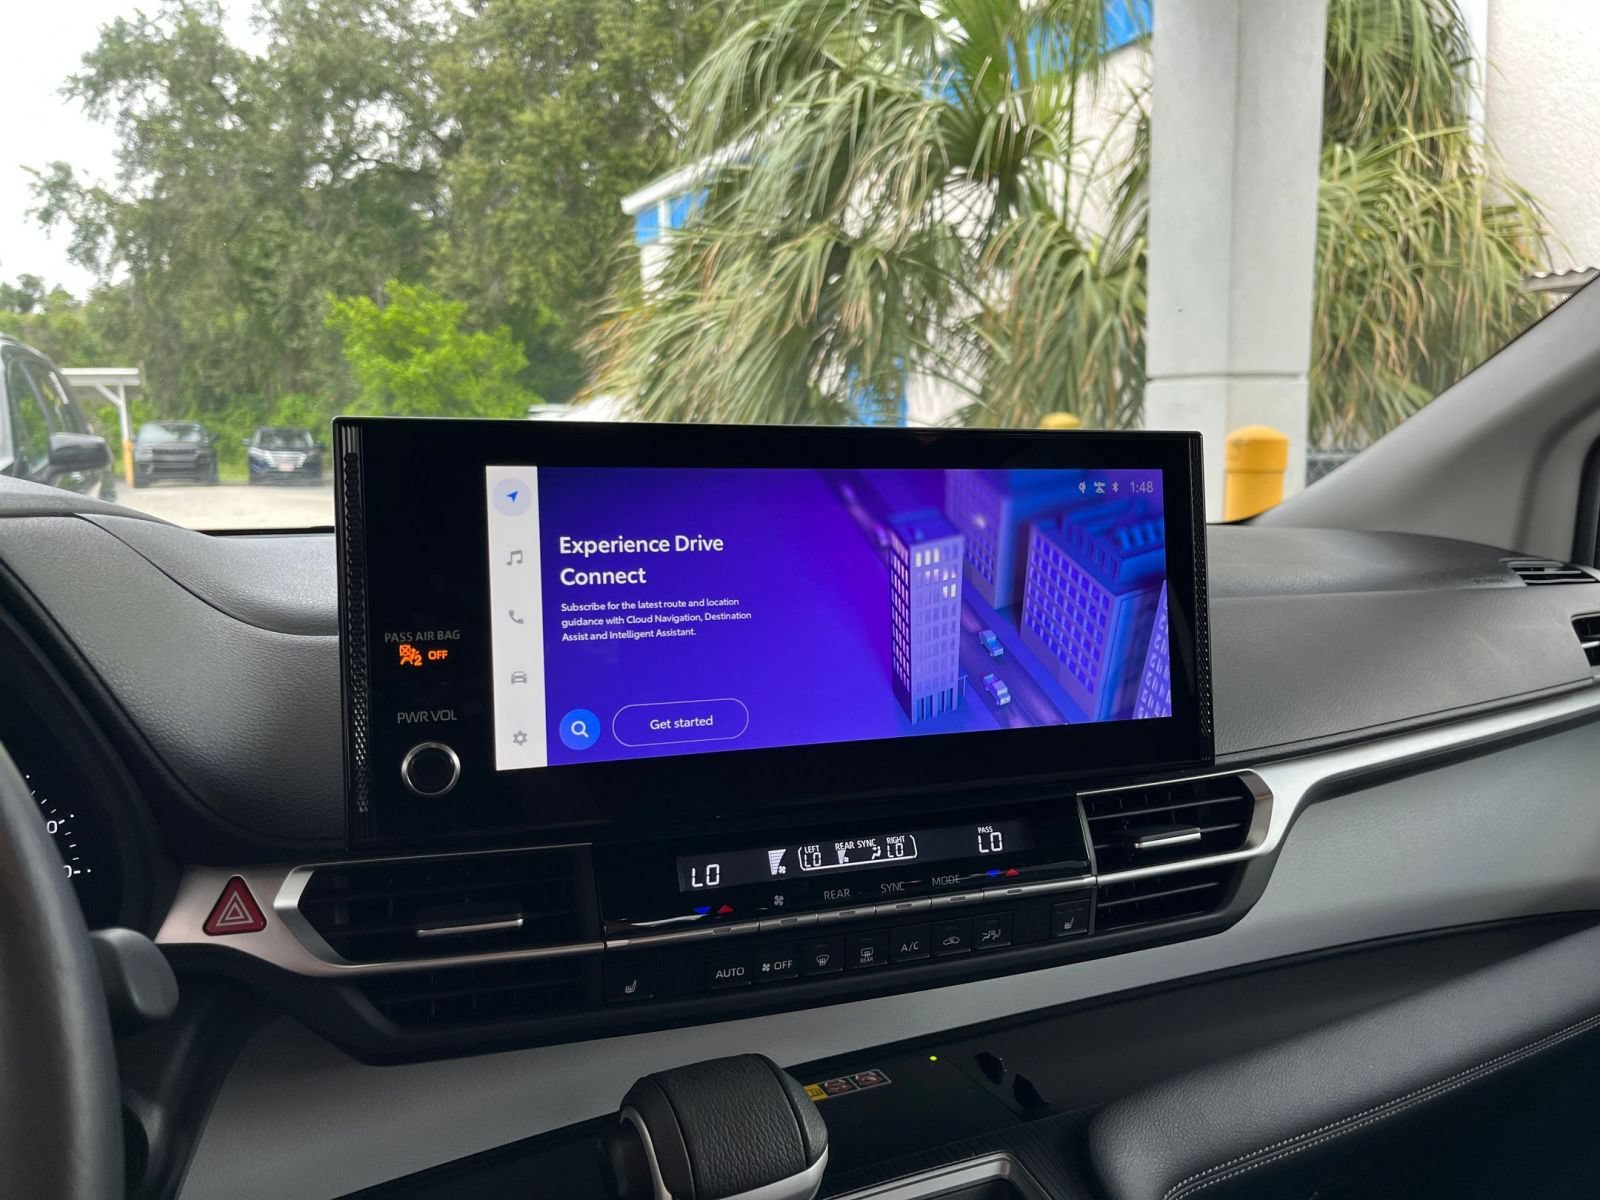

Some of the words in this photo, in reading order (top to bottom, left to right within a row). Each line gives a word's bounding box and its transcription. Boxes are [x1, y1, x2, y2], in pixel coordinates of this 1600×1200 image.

[1130, 481, 1154, 493] 1:48
[559, 535, 670, 557] Experience
[675, 534, 724, 551] Drive
[560, 567, 647, 586] Connect
[561, 602, 606, 612] Subscribe
[607, 601, 620, 610] for
[621, 601, 636, 610] the
[638, 600, 662, 609] latest
[663, 600, 687, 608] route
[688, 598, 705, 607] and
[706, 598, 740, 606] location
[561, 617, 604, 629] guidance
[605, 615, 625, 625] with
[626, 614, 653, 624] Cloud
[654, 614, 703, 624] Navigation,
[704, 611, 752, 621] Destination
[384, 632, 413, 642] PASS
[415, 631, 435, 641] AIR
[437, 629, 460, 640] BAG
[561, 632, 589, 642] Assist
[590, 631, 608, 640] and
[609, 630, 655, 640] Intelligent
[656, 628, 697, 637] Assistant.
[428, 650, 448, 660] OFF
[397, 711, 429, 724] PWR
[430, 709, 458, 722] VOL
[649, 719, 672, 730] Get
[674, 715, 713, 728] started
[834, 841, 855, 850] REAR
[856, 838, 877, 848] SYNC
[886, 836, 905, 844] RIGHT
[978, 831, 1003, 853] LO
[804, 845, 820, 853] LEFT
[692, 864, 720, 887] LO
[931, 875, 961, 886] MODE
[823, 888, 851, 900] REAR
[880, 881, 905, 894] SYNC
[900, 941, 919, 952] A/C
[773, 959, 793, 970] OFF
[715, 966, 745, 979] AUTO
